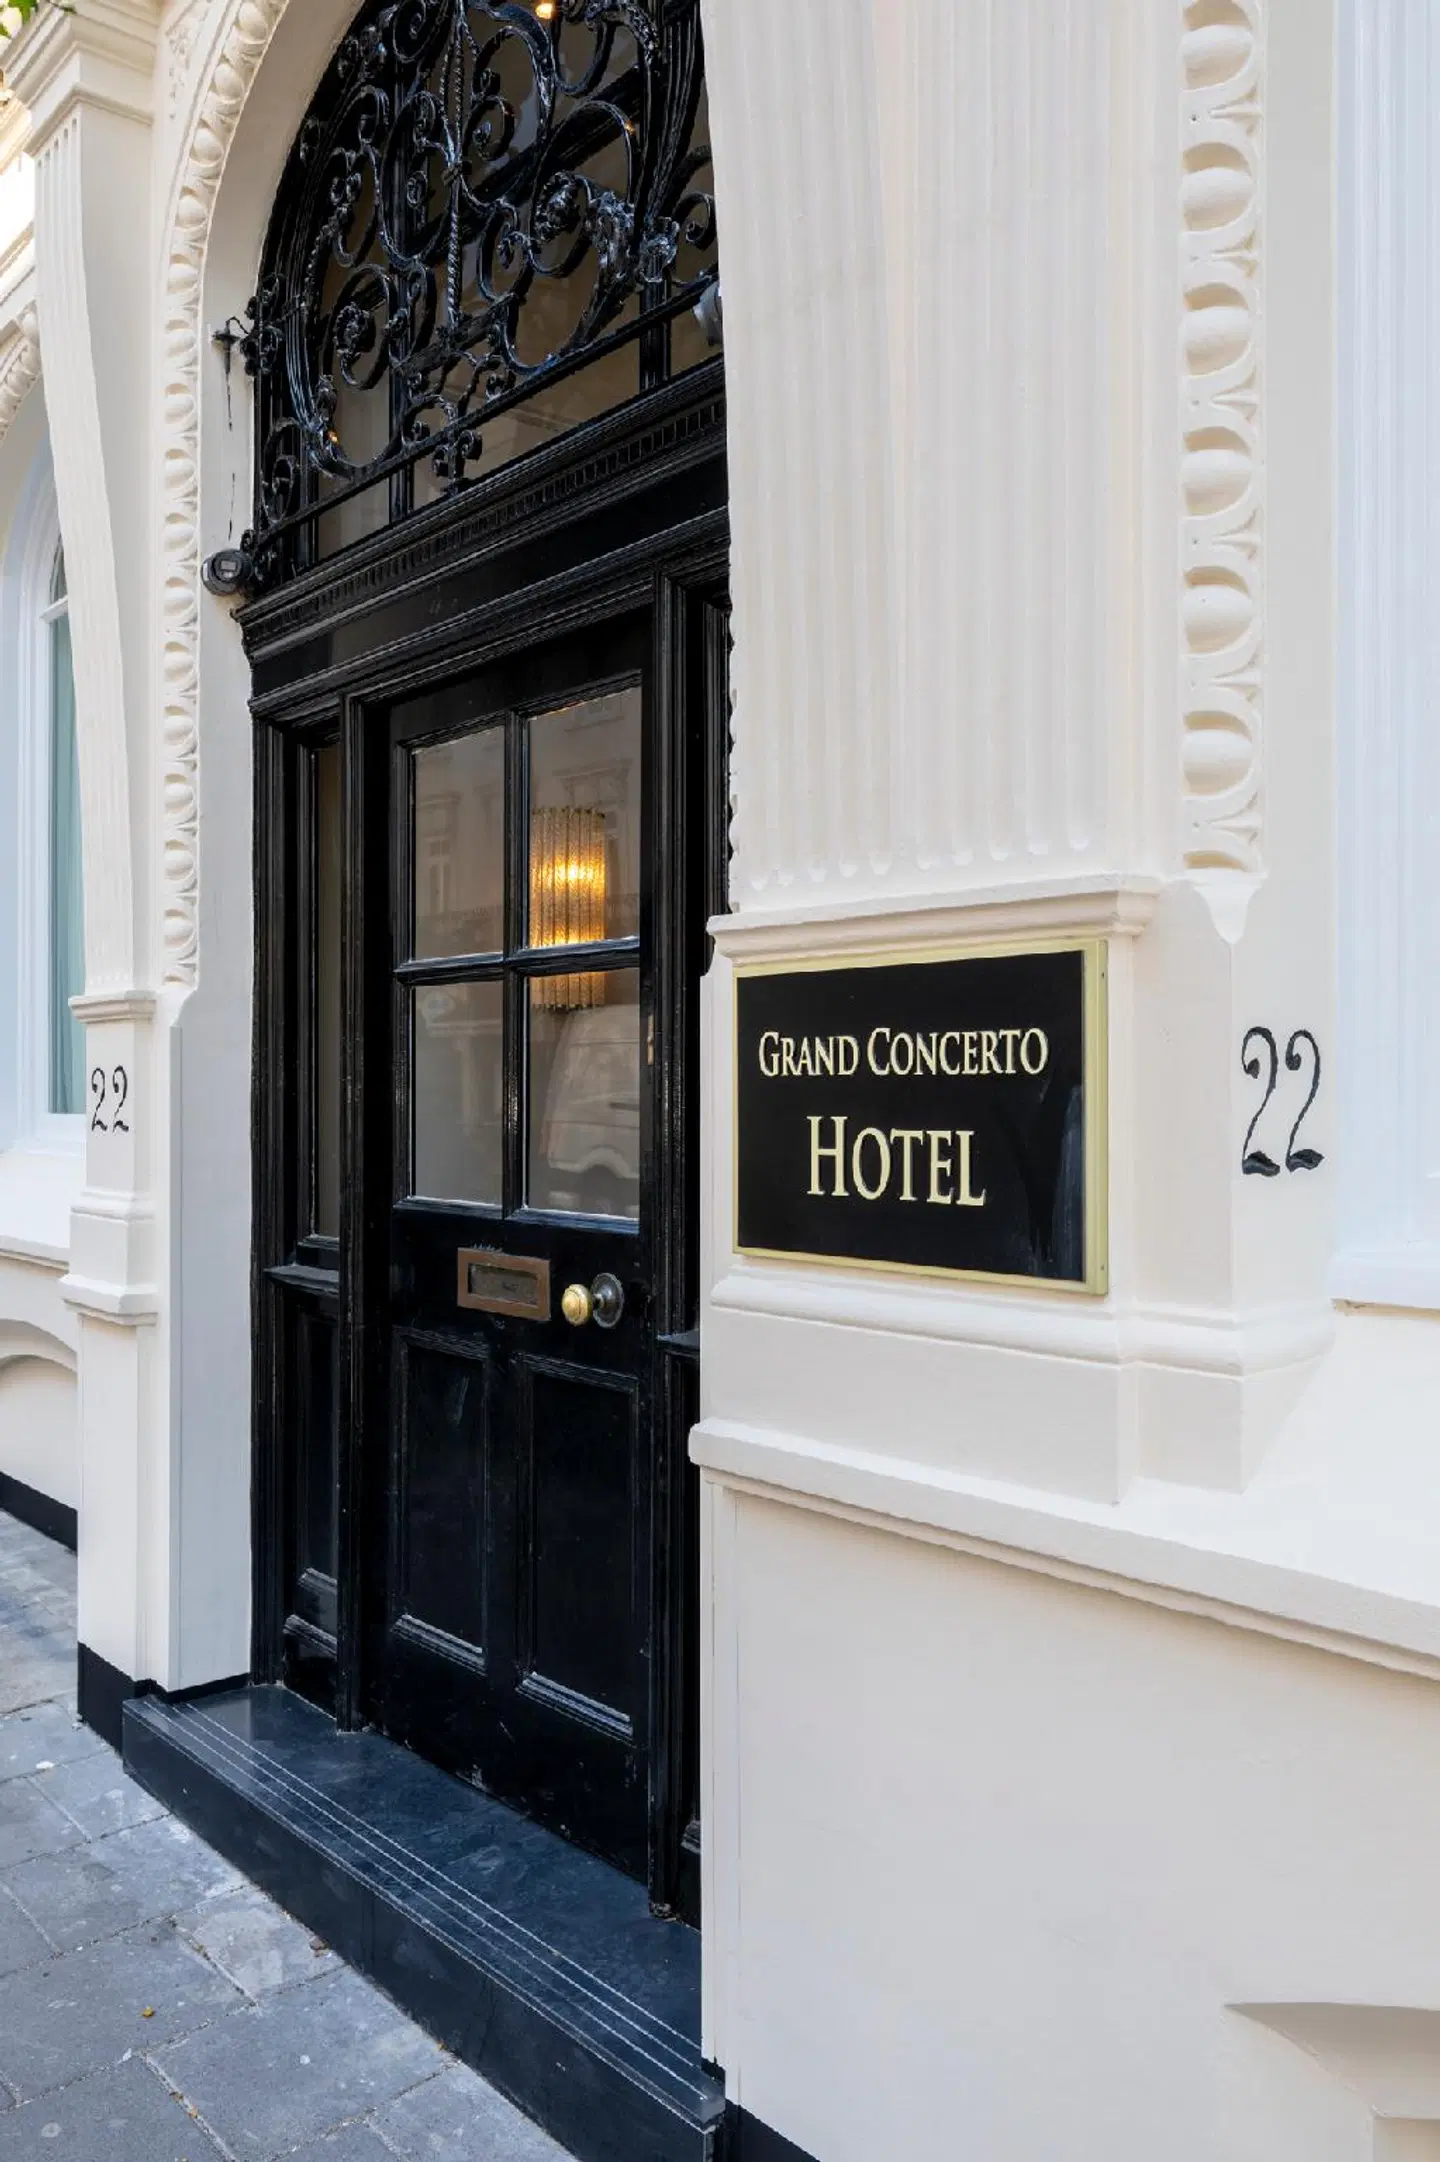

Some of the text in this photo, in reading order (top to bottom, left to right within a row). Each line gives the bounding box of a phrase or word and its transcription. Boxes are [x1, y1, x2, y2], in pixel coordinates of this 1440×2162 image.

[758, 1027, 1049, 1077] GRAND CONCERTO
[91, 1065, 129, 1133] 22
[1241, 1026, 1325, 1178] 22
[806, 1115, 987, 1206] HOTEL
